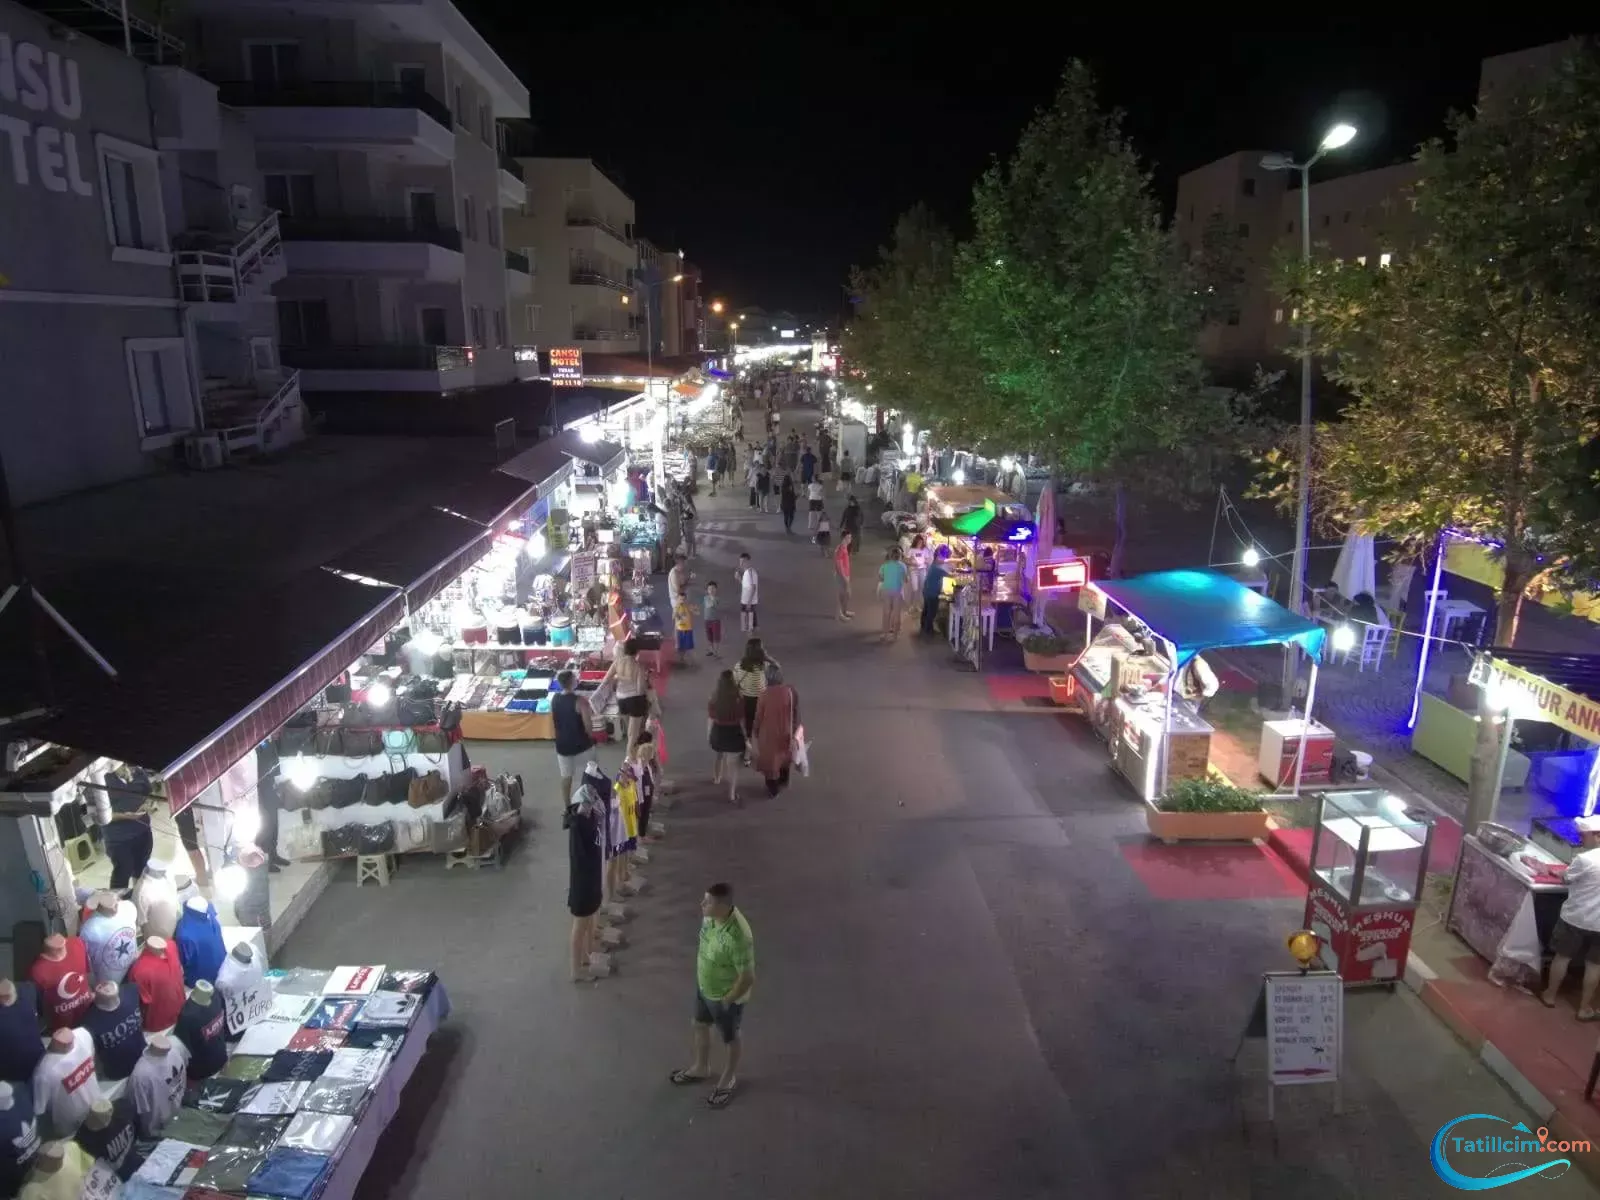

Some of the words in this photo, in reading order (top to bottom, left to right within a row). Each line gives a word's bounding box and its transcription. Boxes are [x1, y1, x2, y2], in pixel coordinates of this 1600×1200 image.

[550, 349, 580, 358] CANSU
[550, 358, 580, 366] MOTEL
[229, 1011, 245, 1031] 10
